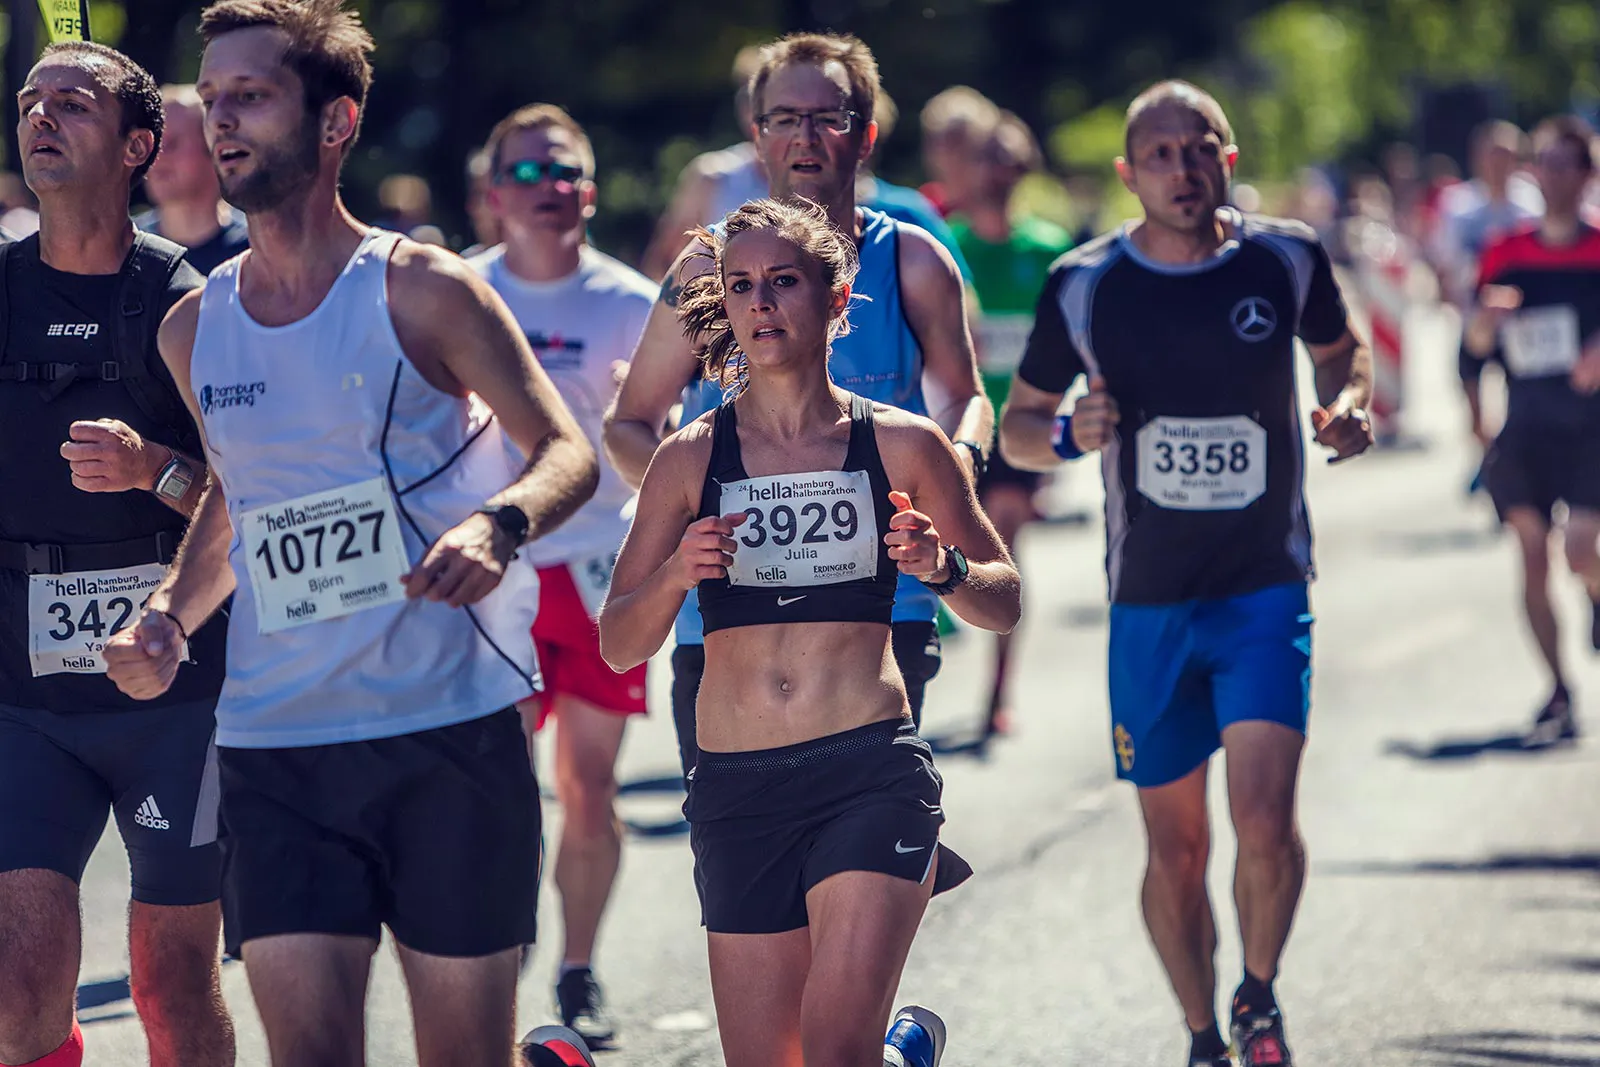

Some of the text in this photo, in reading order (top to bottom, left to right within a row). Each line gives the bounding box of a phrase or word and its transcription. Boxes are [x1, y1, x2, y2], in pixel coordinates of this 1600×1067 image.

[64, 323, 99, 339] cep
[214, 381, 266, 398] hamburg
[214, 394, 255, 409] running
[1155, 441, 1250, 475] 3358
[749, 482, 792, 501] hella
[792, 480, 834, 489] hamburg
[793, 487, 856, 498] halbmarathon
[265, 507, 307, 532] hella
[304, 497, 345, 513] hamburg
[306, 500, 373, 521] halbmarathon
[740, 500, 858, 548] 3929
[256, 510, 385, 580] 10727
[784, 548, 818, 561] Julia
[755, 567, 787, 580] hella
[813, 563, 848, 573] ERDINGER
[55, 578, 98, 596] hella
[97, 574, 139, 586] hamburg
[98, 579, 161, 594] halbmarathon
[47, 592, 153, 641] 342
[286, 601, 317, 619] hella
[84, 641, 106, 652] Ya
[63, 657, 95, 668] hella
[134, 813, 170, 830] adidas
